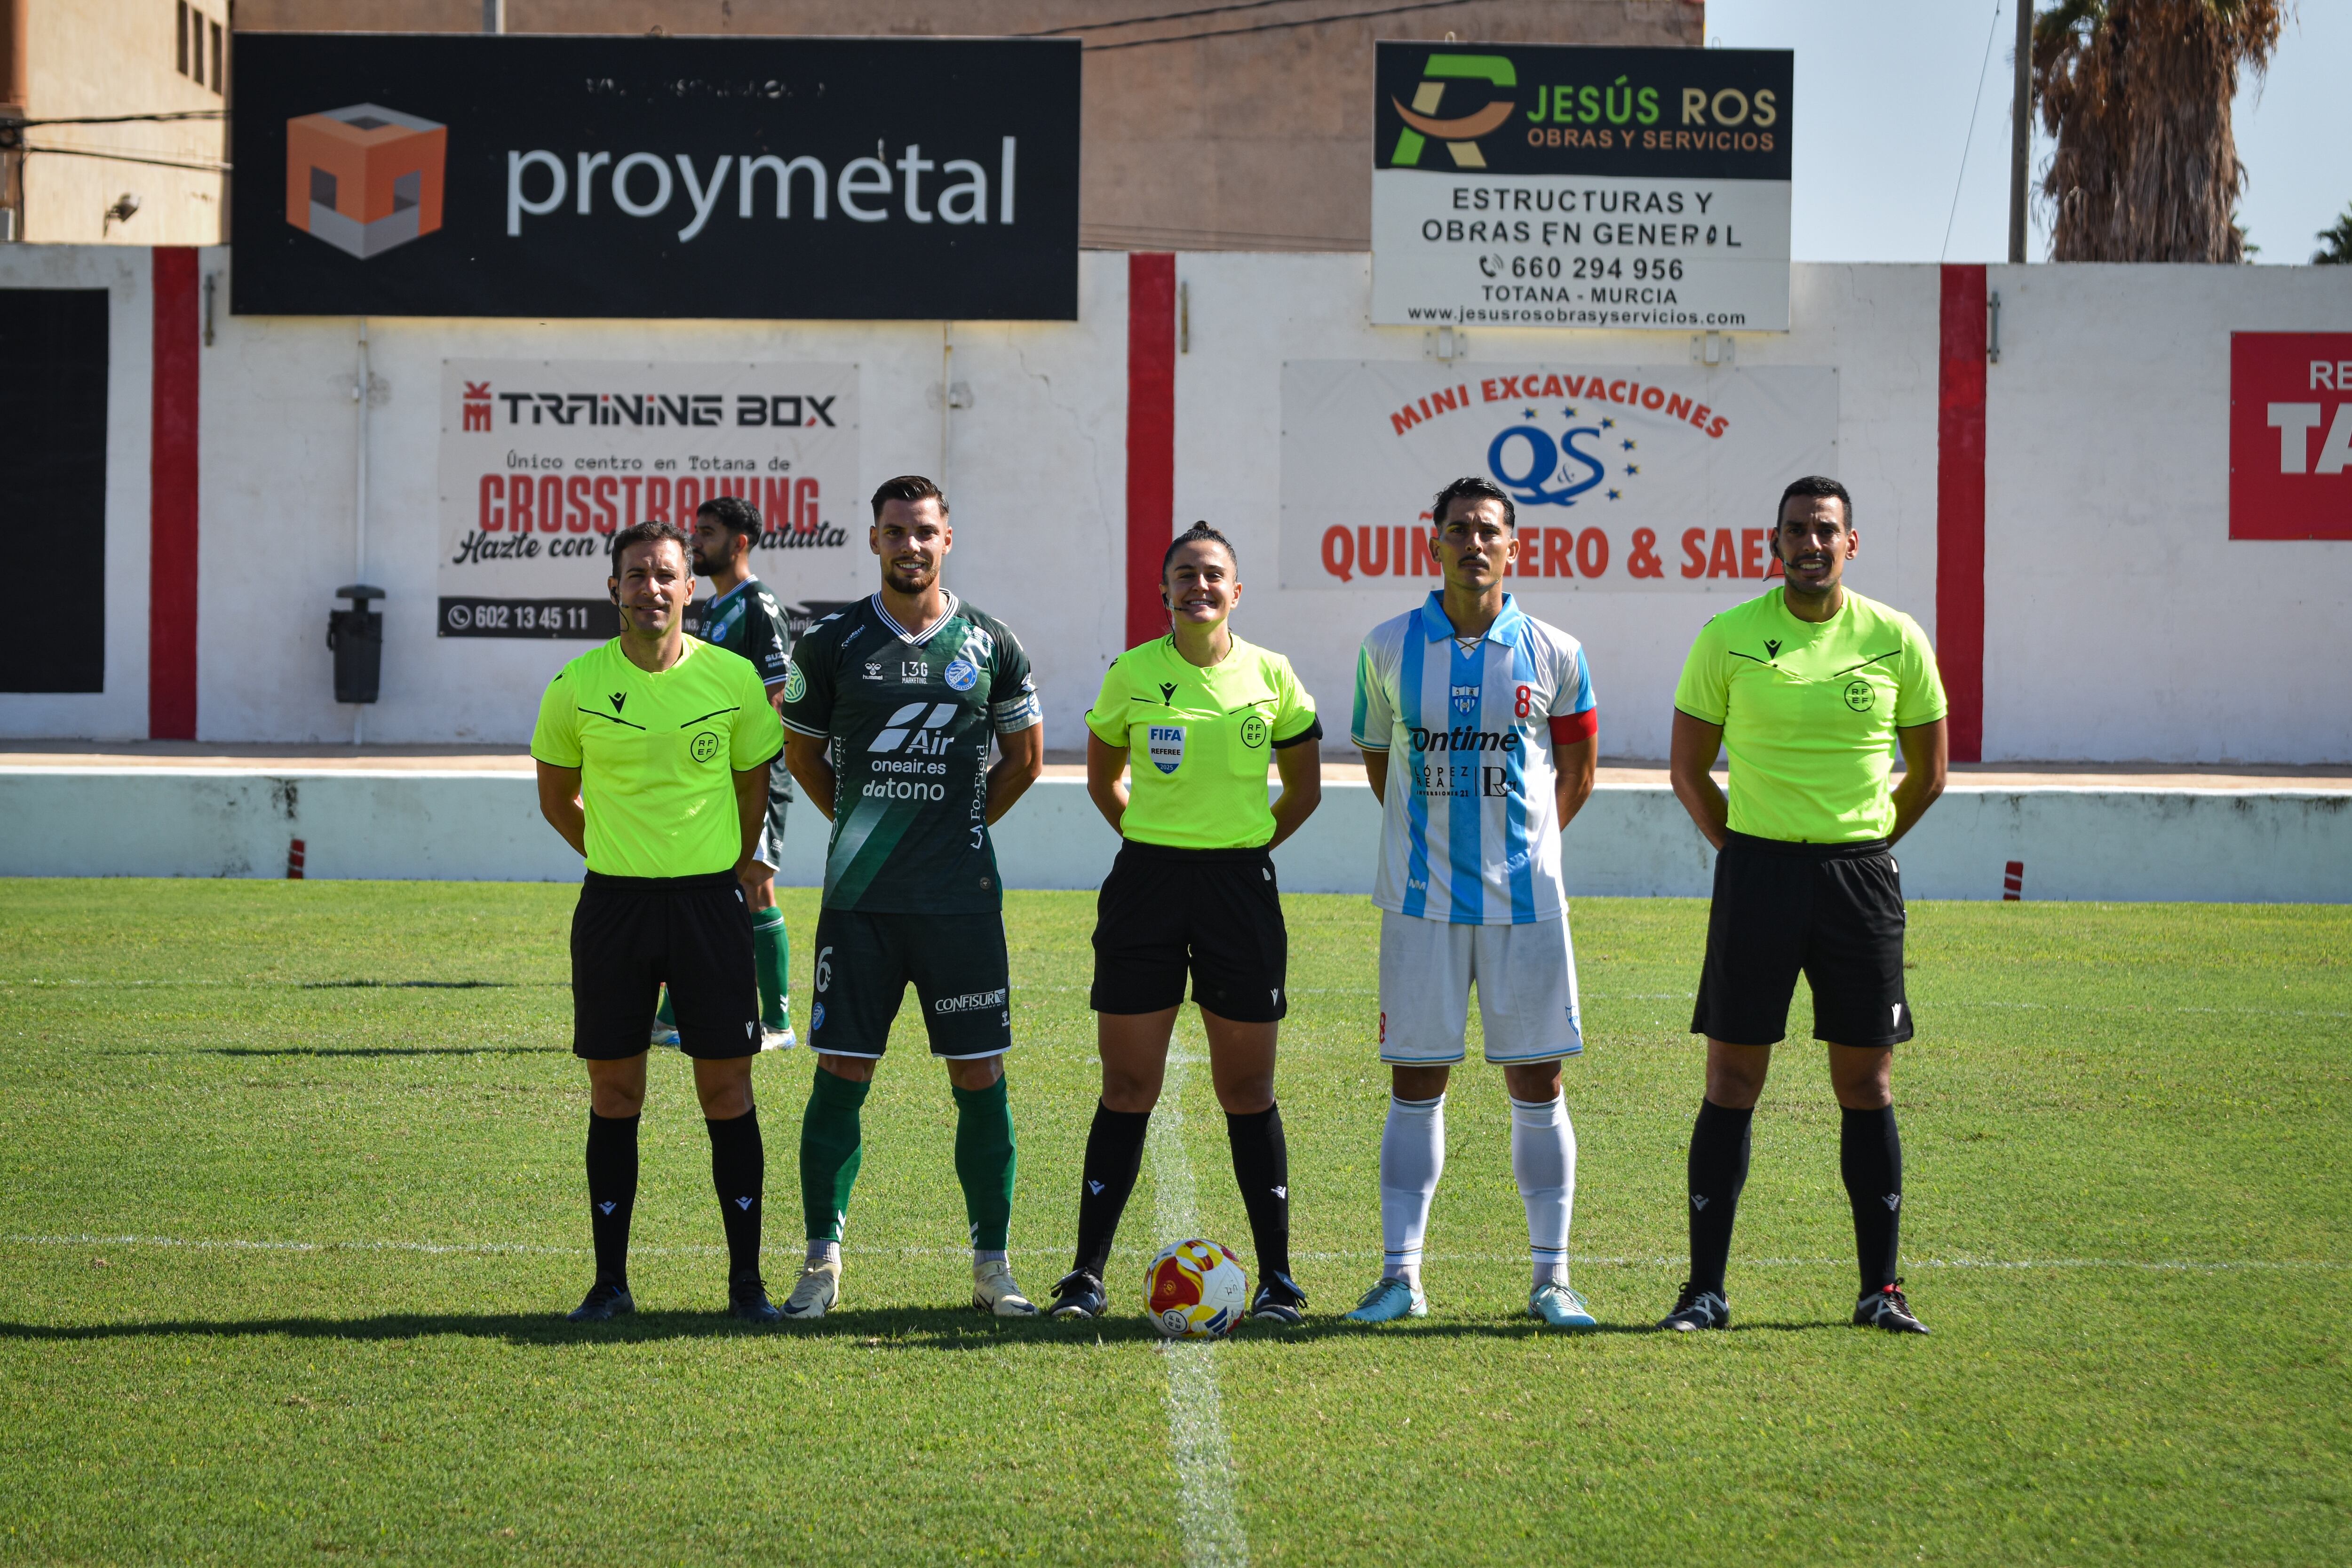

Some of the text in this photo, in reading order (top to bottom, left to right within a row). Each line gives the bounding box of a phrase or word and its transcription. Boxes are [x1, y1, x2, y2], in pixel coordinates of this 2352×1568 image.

[1526, 74, 1776, 127] JESÚS ROS
[1527, 128, 1774, 151] OBRAS Y SERVICIOS
[507, 135, 1016, 243] proymetal
[1453, 187, 1713, 214] ESTRUCTURAS Y
[1422, 218, 1530, 241] OBRAS
[1512, 255, 1683, 280] 660 294 956
[1482, 285, 1570, 302] TOTANA
[1591, 287, 1678, 304] MURCIA
[1408, 305, 1746, 325] www.jesusrosobrasyservicios.com
[737, 394, 837, 427] BOX
[1390, 373, 1730, 439] MINI EXCAVACIONES
[507, 449, 791, 471] Único centro en Totana de
[452, 529, 541, 565] Hazte
[548, 536, 598, 557] con
[1627, 526, 1665, 579] &
[475, 605, 510, 629] 602
[514, 605, 536, 629] 13
[538, 606, 563, 630] 45
[567, 607, 588, 630] 11
[1514, 685, 1531, 718] 8
[905, 729, 954, 755] Air
[1151, 728, 1182, 741] FIFA
[1409, 725, 1519, 752] Ontime
[871, 758, 946, 774] oneair.es
[1414, 764, 1468, 777] LÓPEZ
[862, 778, 945, 801] datono
[1416, 777, 1454, 788] REAL
[816, 946, 833, 993] 6
[935, 992, 994, 1012] CONFISUR
